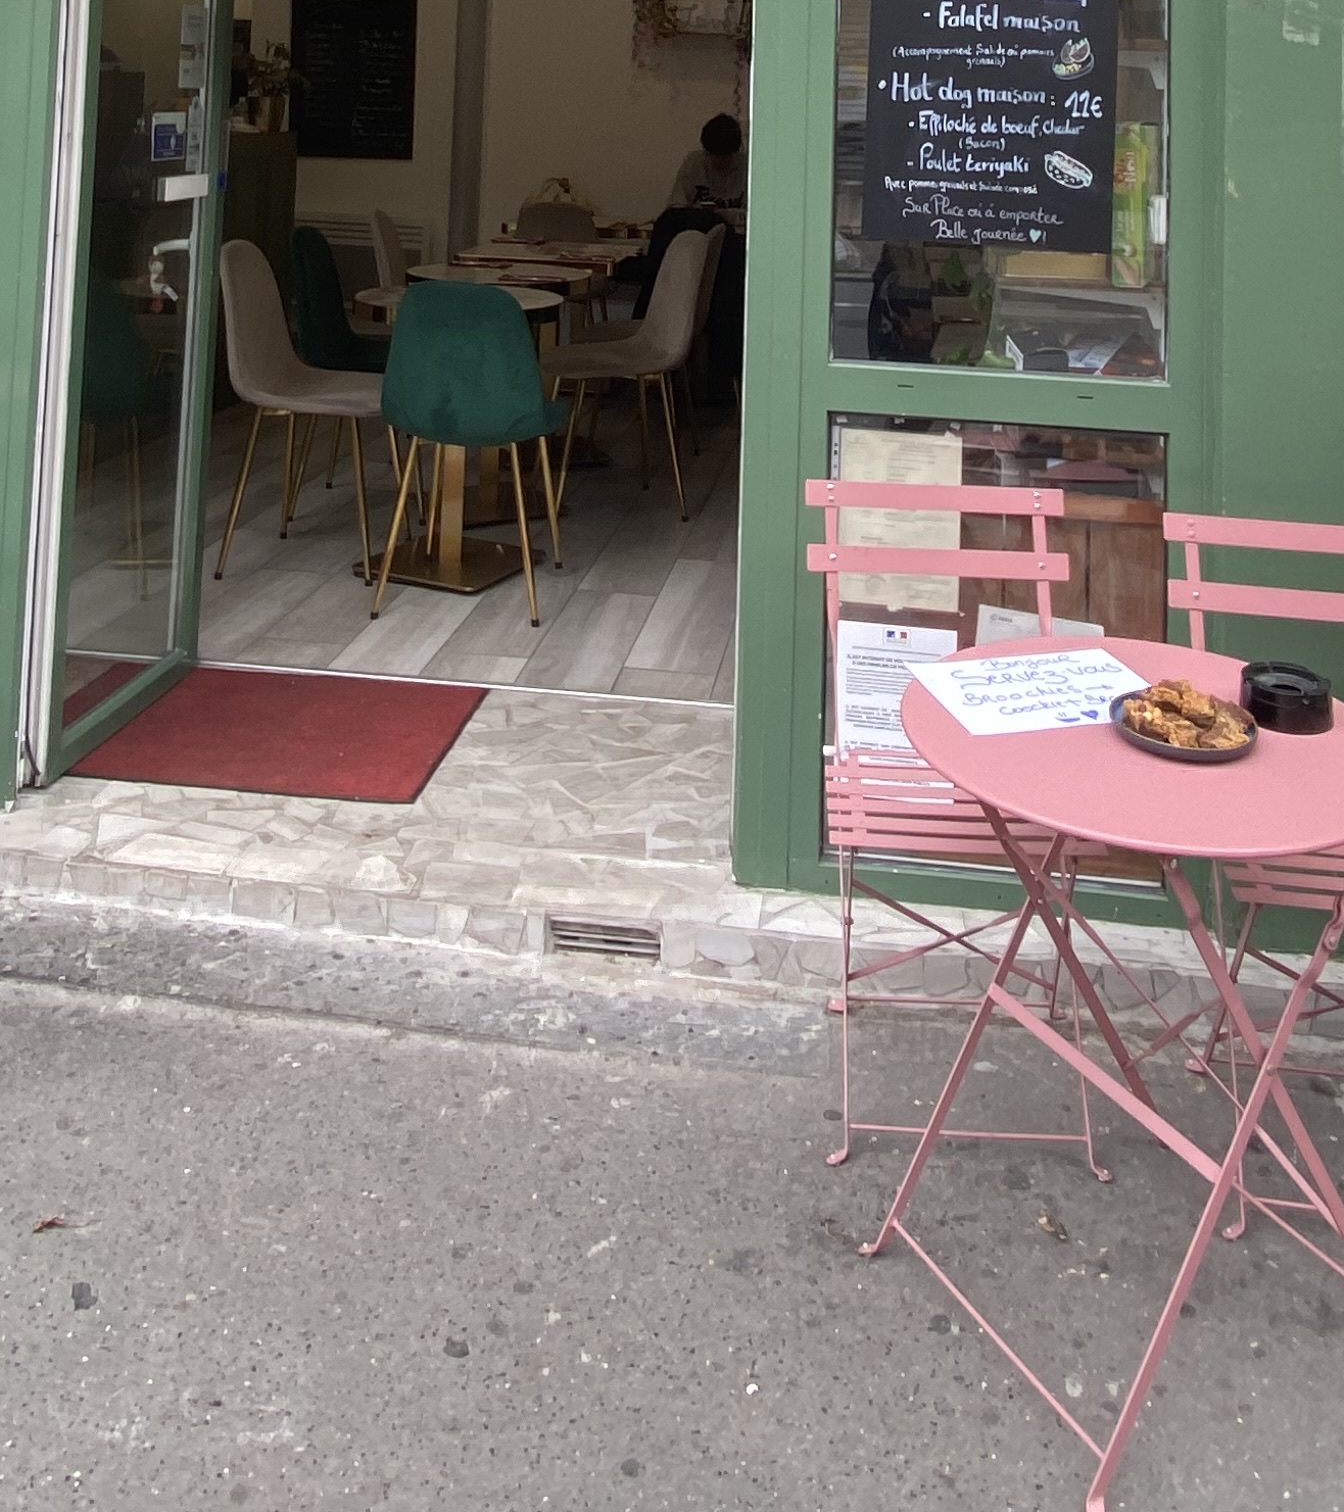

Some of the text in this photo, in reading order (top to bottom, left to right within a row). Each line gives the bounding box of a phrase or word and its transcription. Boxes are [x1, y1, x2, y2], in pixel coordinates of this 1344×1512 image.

[939, 1, 1080, 34] Falafel maison
[891, 72, 933, 103] Hot
[938, 76, 973, 109] dog
[977, 87, 1045, 105] maison
[980, 115, 998, 134] de
[919, 142, 961, 173] Poulet
[930, 219, 968, 239] Belle
